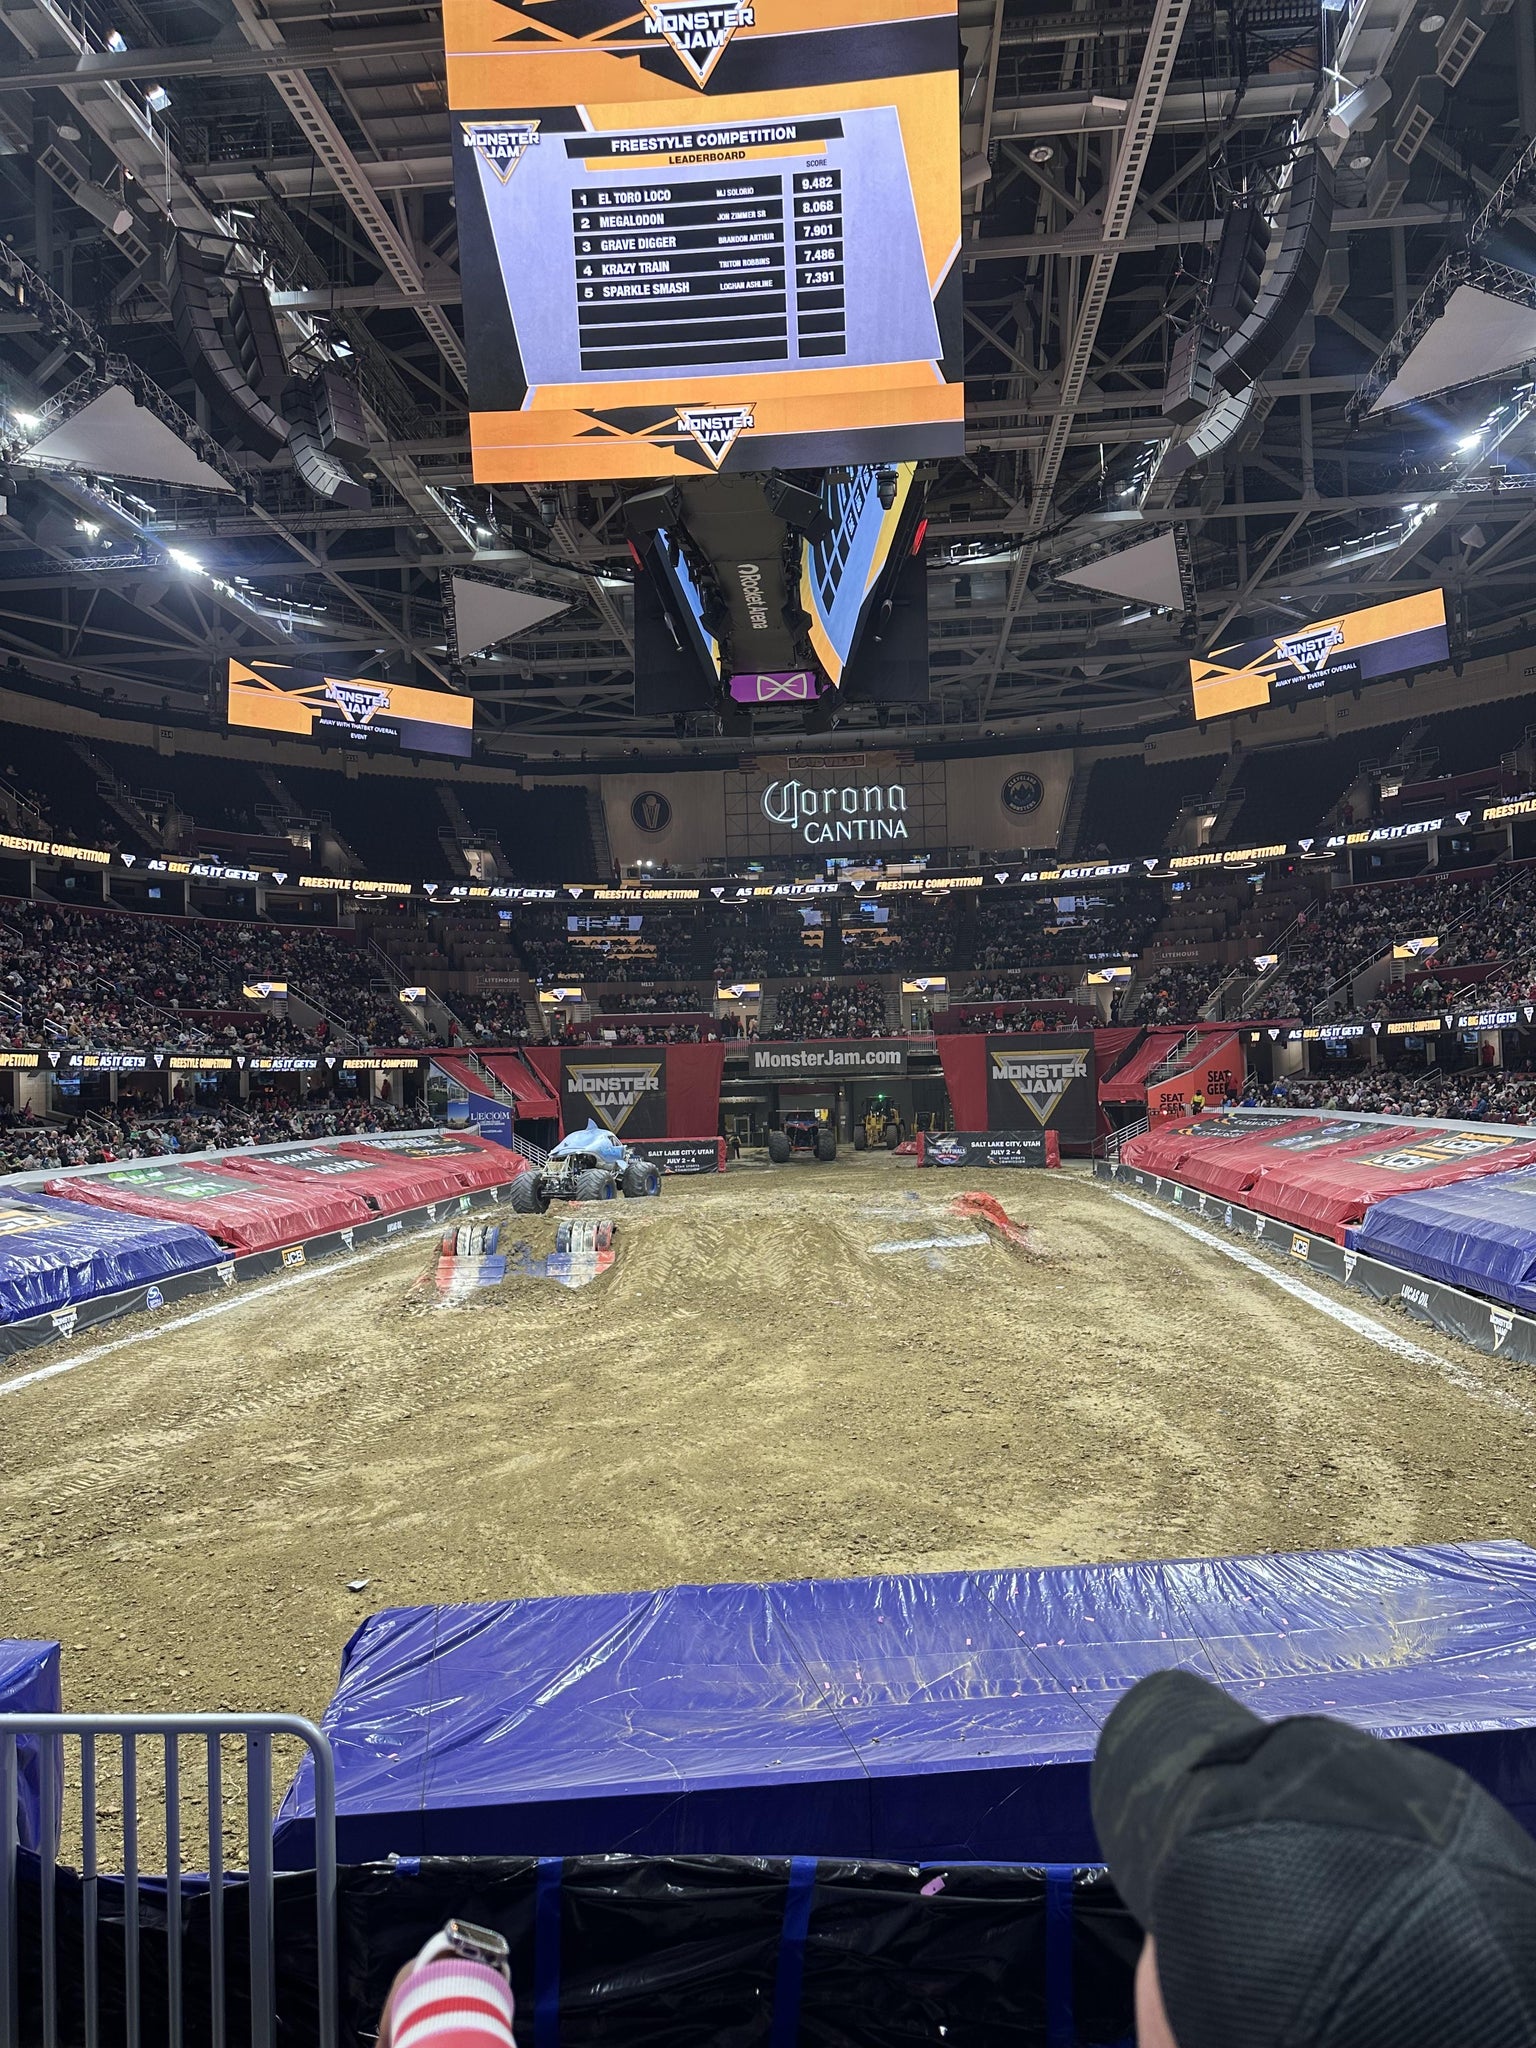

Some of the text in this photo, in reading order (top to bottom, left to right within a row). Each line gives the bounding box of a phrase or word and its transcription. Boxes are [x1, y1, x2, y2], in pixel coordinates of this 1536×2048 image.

[644, 7, 755, 35] MONSTER
[676, 28, 726, 49] JAM
[463, 131, 541, 148] MONSTER
[611, 126, 797, 153] FREESTYLE COMPETITION
[485, 144, 521, 160] JAM
[668, 150, 746, 165] LEADERBOARD
[806, 158, 828, 168] SCORE
[802, 177, 833, 190] 9.482
[580, 195, 588, 206] 1
[598, 189, 671, 205] EL TORO LOCO
[716, 189, 726, 198] MJ
[802, 200, 834, 213] 8.068
[580, 218, 590, 229] 2
[599, 213, 665, 228] MEGALODON
[749, 232, 775, 242] ARTHUR
[803, 224, 833, 237] 7.901
[582, 241, 592, 252] 3
[601, 236, 677, 251] GRAVE DIGGER
[804, 248, 835, 262] 7.486
[583, 265, 593, 277] 4
[602, 260, 670, 275] KRAZY TRAIN
[805, 271, 835, 284] 7.391
[584, 287, 594, 298] 5
[602, 281, 690, 297] SPARKLE SMASH
[677, 415, 756, 432] MONSTER
[697, 428, 736, 443] JAM
[739, 574, 769, 630] Rocket Arena
[1277, 631, 1344, 660] MONSTER
[1294, 650, 1326, 665] JAM
[1275, 678, 1292, 688] AWAY
[1292, 675, 1307, 685] WITH
[1331, 662, 1357, 676] OVERALL
[1307, 680, 1326, 690] EVENT
[325, 688, 390, 709] MONSTER
[342, 702, 373, 716] JAM
[319, 718, 336, 727] AWAY
[336, 720, 350, 728] WITH
[374, 725, 398, 736] OVERALL
[350, 733, 368, 741] EVENT
[760, 779, 908, 829] Corona
[1482, 799, 1536, 821] FREESTYLE
[803, 818, 909, 844] CANTINA
[1326, 818, 1442, 848] AS BIG AS IT GETS!
[0, 834, 111, 864] FREESTYLE COMPETITION
[1169, 844, 1287, 868] FREESTYLE COMPETITION
[148, 859, 260, 881] AS BIG AS IT GETS!
[1021, 863, 1130, 882] AS BIG AS IT GETS!
[299, 876, 411, 894] FREESTYLE COMPETITION
[736, 883, 839, 897] AS BIG AS IT GETS!
[876, 876, 983, 891] FREESTYLE COMPETITION
[450, 886, 556, 898] AS BIG AS IT GETS!
[594, 889, 699, 900] FREESTYLE COMPETITION
[1161, 950, 1199, 959] LITEHOUSE
[1458, 1016, 1467, 1027] AS
[1467, 1015, 1479, 1026] BIG
[1479, 1014, 1488, 1025] AS
[1496, 1011, 1517, 1024] GETS!
[1288, 1029, 1303, 1039] AS
[1303, 1029, 1319, 1038] BIG
[1319, 1028, 1332, 1038] AS
[1341, 1025, 1364, 1036] GETS!
[69, 1055, 84, 1067] AS
[83, 1055, 99, 1067] BIG
[99, 1055, 113, 1067] AS
[122, 1056, 146, 1067] GETS!
[343, 1059, 380, 1069] FREESTYLE
[754, 1049, 901, 1068] MonsterJam.com
[992, 1063, 1087, 1080] MONSTER
[567, 1077, 659, 1093] MONSTER
[1020, 1079, 1063, 1093] JAM
[1207, 1083, 1228, 1096] GEE
[594, 1092, 635, 1106] JAM
[1160, 1093, 1184, 1103] SEAT
[470, 1112, 510, 1121] LECOM
[1373, 1153, 1434, 1168] JCB
[1294, 1238, 1309, 1256] JCB
[285, 1249, 304, 1265] JCB
[1401, 1284, 1430, 1308] LUCAS OIL
